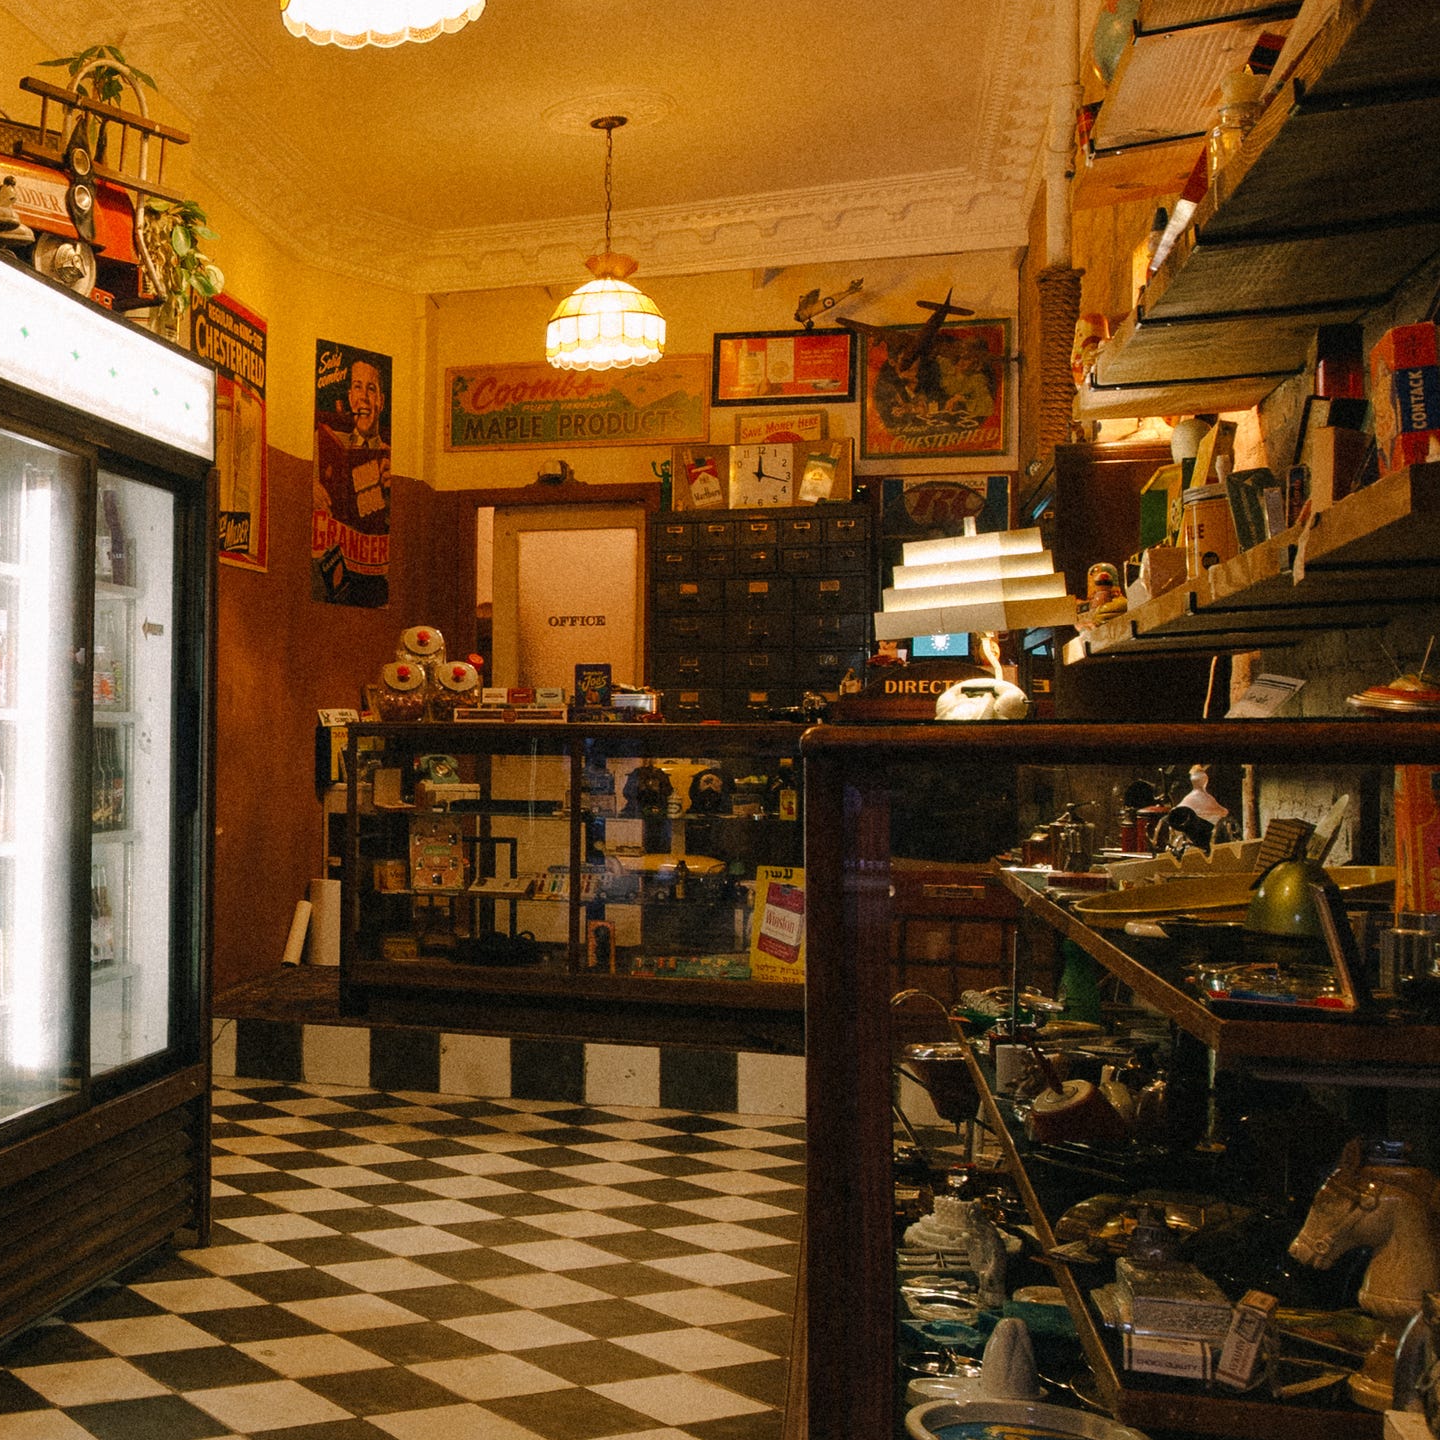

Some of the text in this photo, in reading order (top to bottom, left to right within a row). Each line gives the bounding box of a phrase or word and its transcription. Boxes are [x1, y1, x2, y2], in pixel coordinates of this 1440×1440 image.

[195, 313, 265, 389] CHESTERFIELD
[472, 371, 604, 410] Coombs
[1410, 369, 1427, 430] CONTACK
[464, 410, 687, 440] MAPLE PRODUCTS
[765, 420, 795, 433] MONEY
[798, 416, 819, 428] HERE
[891, 427, 1001, 454] CHESTERFIELD
[312, 510, 389, 564] GRANGER
[548, 615, 606, 627] OFFICE
[884, 679, 958, 695] DIRECT
[766, 909, 796, 934] Winston
